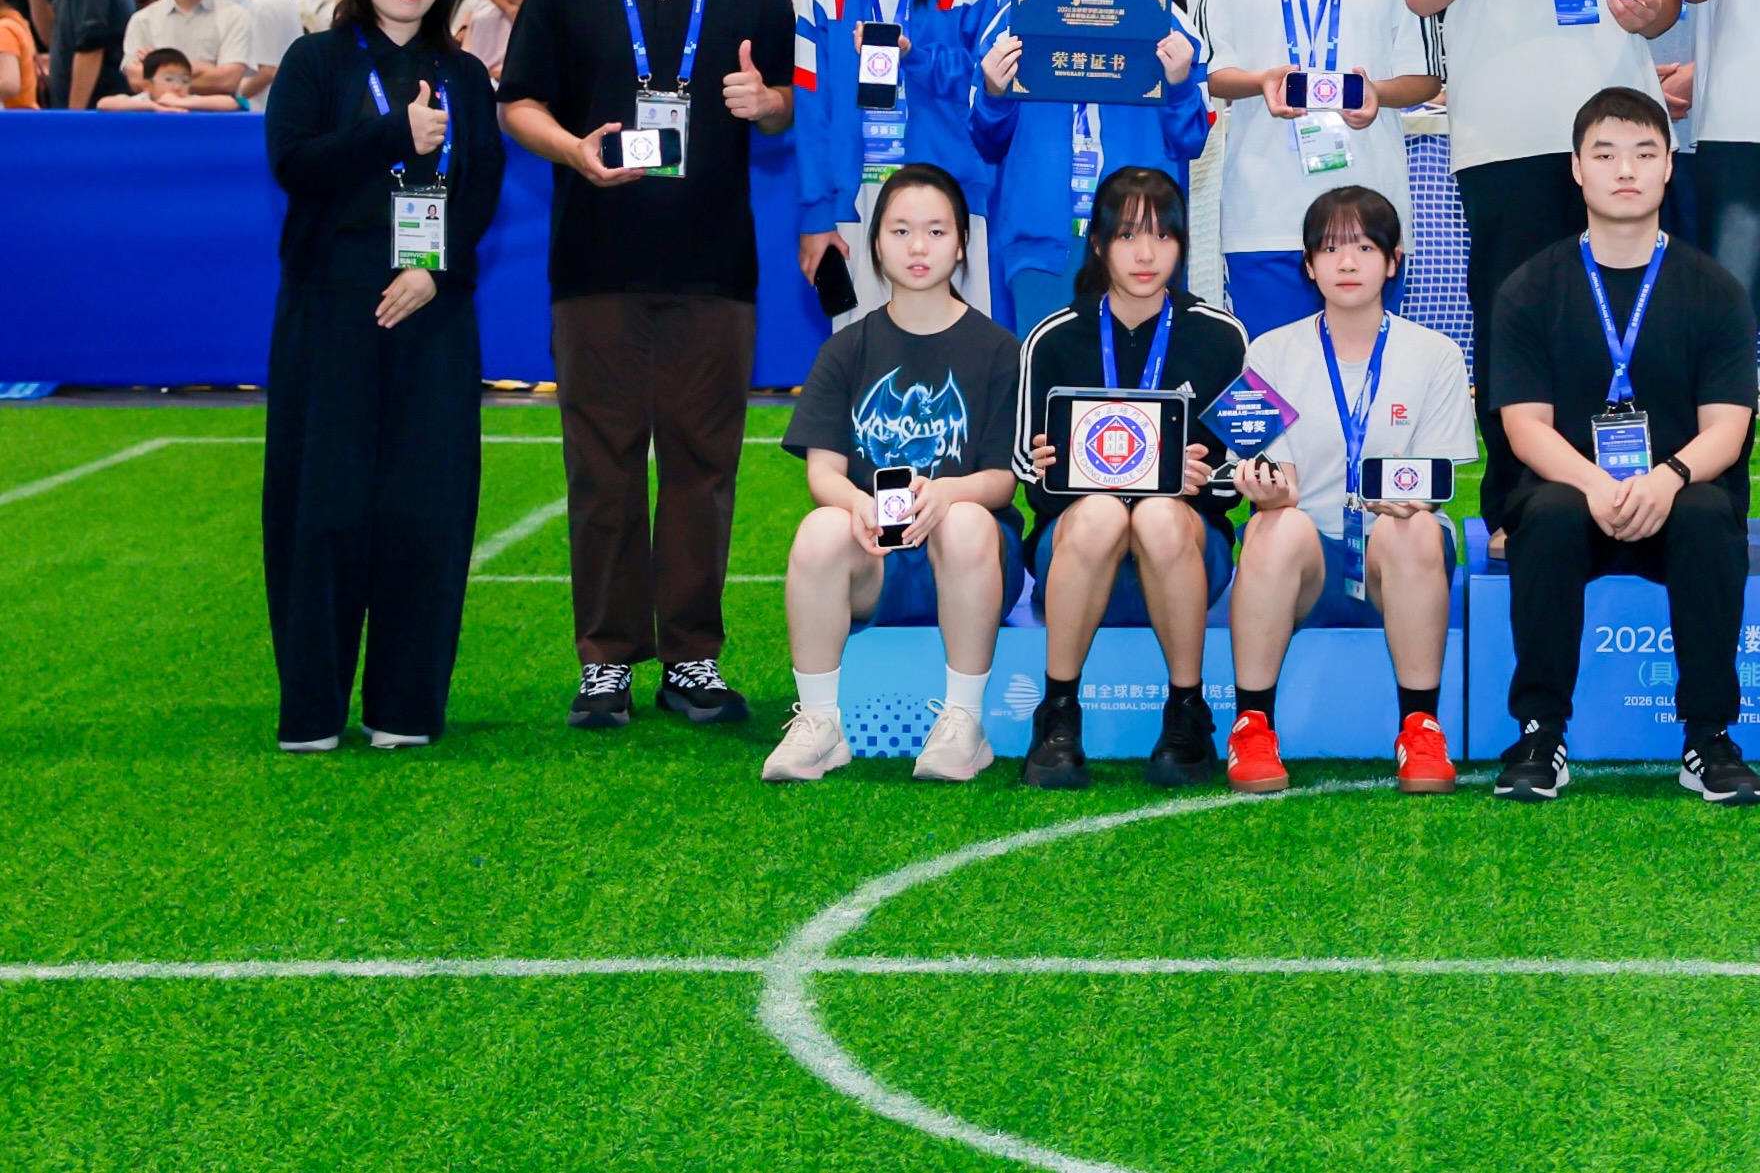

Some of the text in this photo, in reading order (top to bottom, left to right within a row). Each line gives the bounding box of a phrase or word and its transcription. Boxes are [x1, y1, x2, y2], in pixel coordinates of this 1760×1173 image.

[1051, 51, 1126, 71] 荣誉证书
[1230, 420, 1266, 433] 二等奖
[1102, 473, 1136, 485] MIDDLE
[1137, 442, 1156, 475] SCHOOL
[1100, 702, 1138, 710] GLOBAL
[1140, 702, 1165, 710] DIGIT
[1624, 696, 1652, 707] 2026
